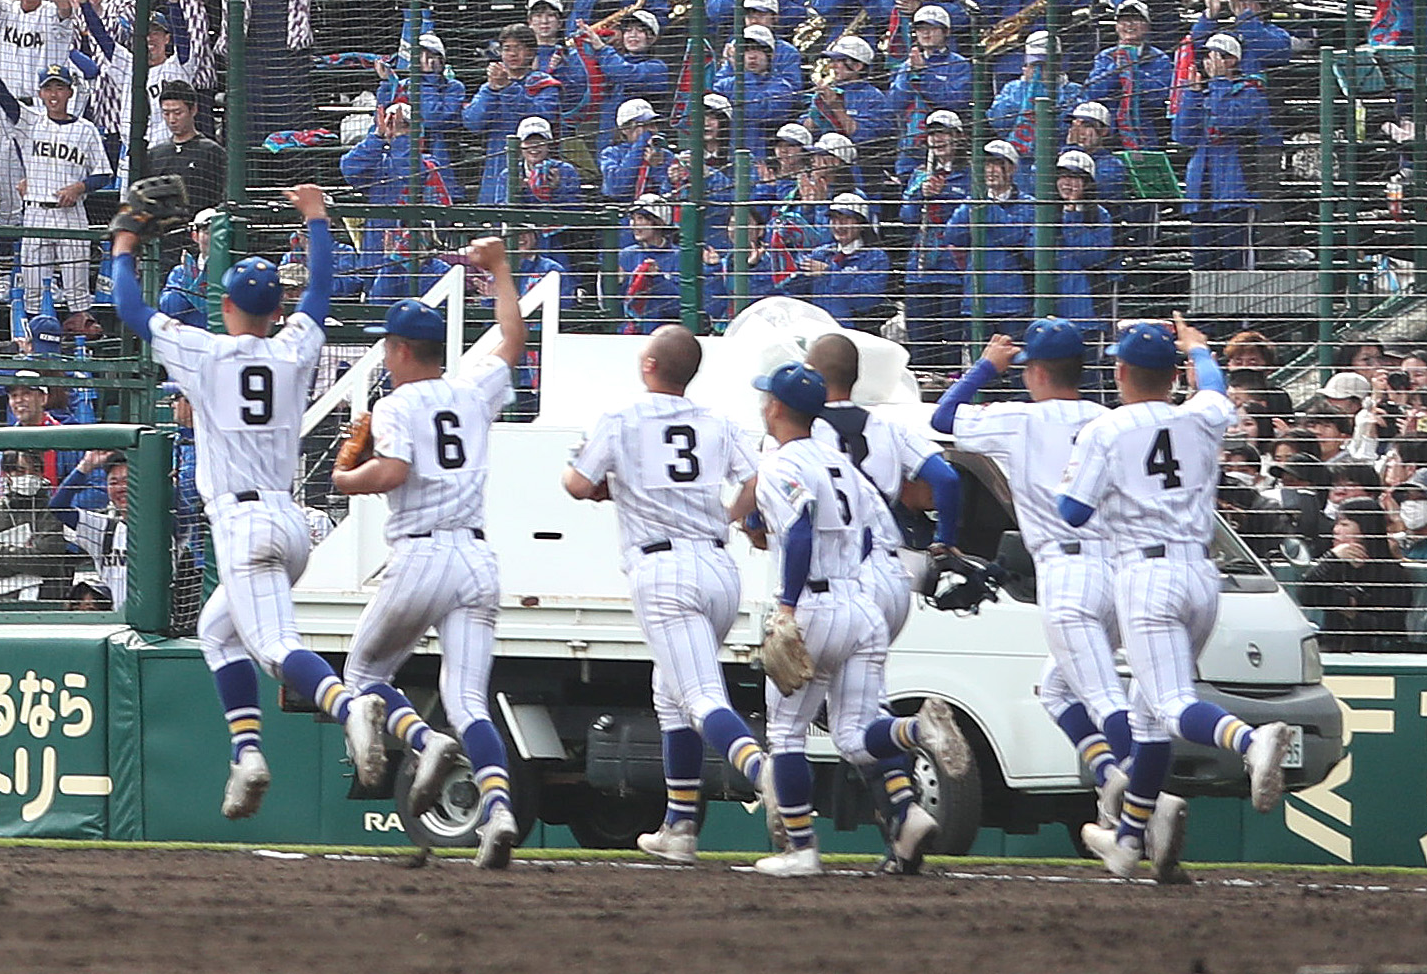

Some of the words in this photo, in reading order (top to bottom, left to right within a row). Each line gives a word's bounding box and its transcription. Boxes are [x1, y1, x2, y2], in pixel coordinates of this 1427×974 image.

[31, 139, 84, 166] KENDAI
[239, 364, 275, 427] 9
[433, 409, 467, 470] 6
[662, 423, 700, 484] 3
[1145, 426, 1183, 490] 4
